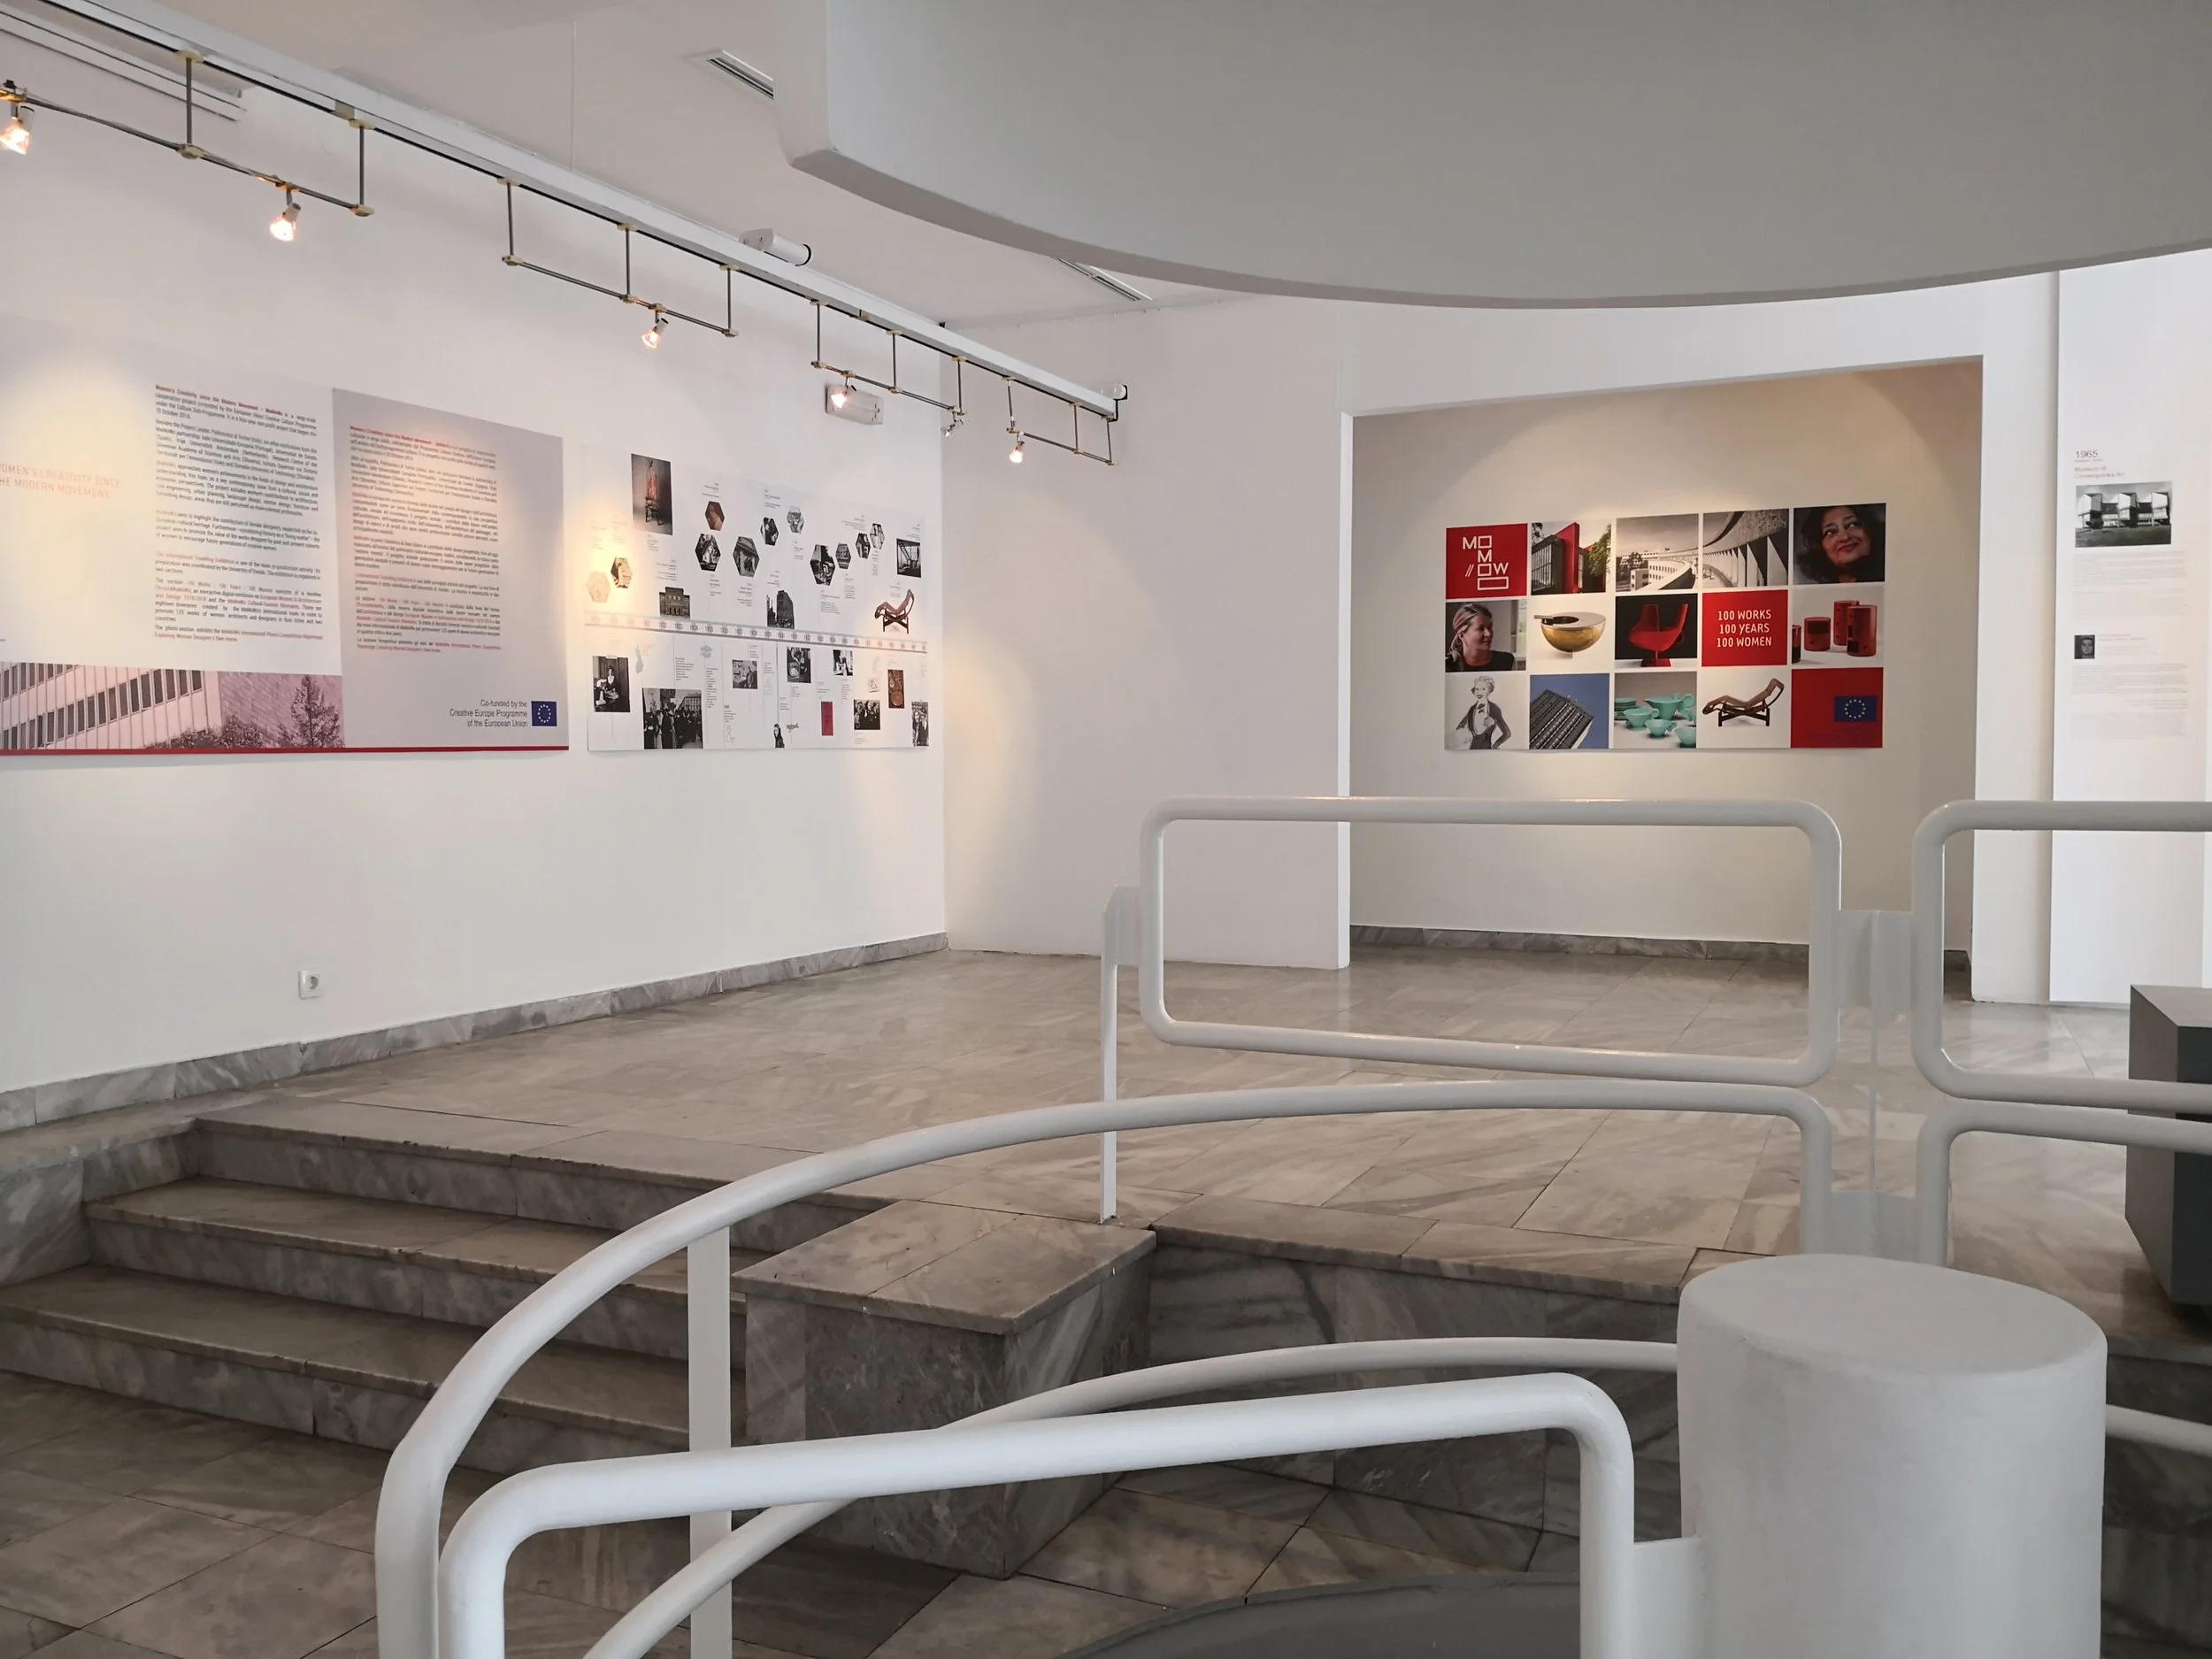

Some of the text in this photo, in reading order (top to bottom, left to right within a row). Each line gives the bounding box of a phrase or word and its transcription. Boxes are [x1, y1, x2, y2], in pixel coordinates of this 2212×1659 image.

[2076, 450, 2098, 458] 1965
[0, 463, 121, 488] OMEN'S CREATIVITY SINCE
[15, 478, 54, 492] MODERN
[58, 484, 108, 498] MOVEMENT
[1718, 609, 1771, 621] 100 WORKS
[1720, 623, 1770, 635] 100 YEARS
[1717, 637, 1772, 647] 100 WOMEN
[475, 709, 495, 717] Europe
[497, 710, 528, 718] Programme
